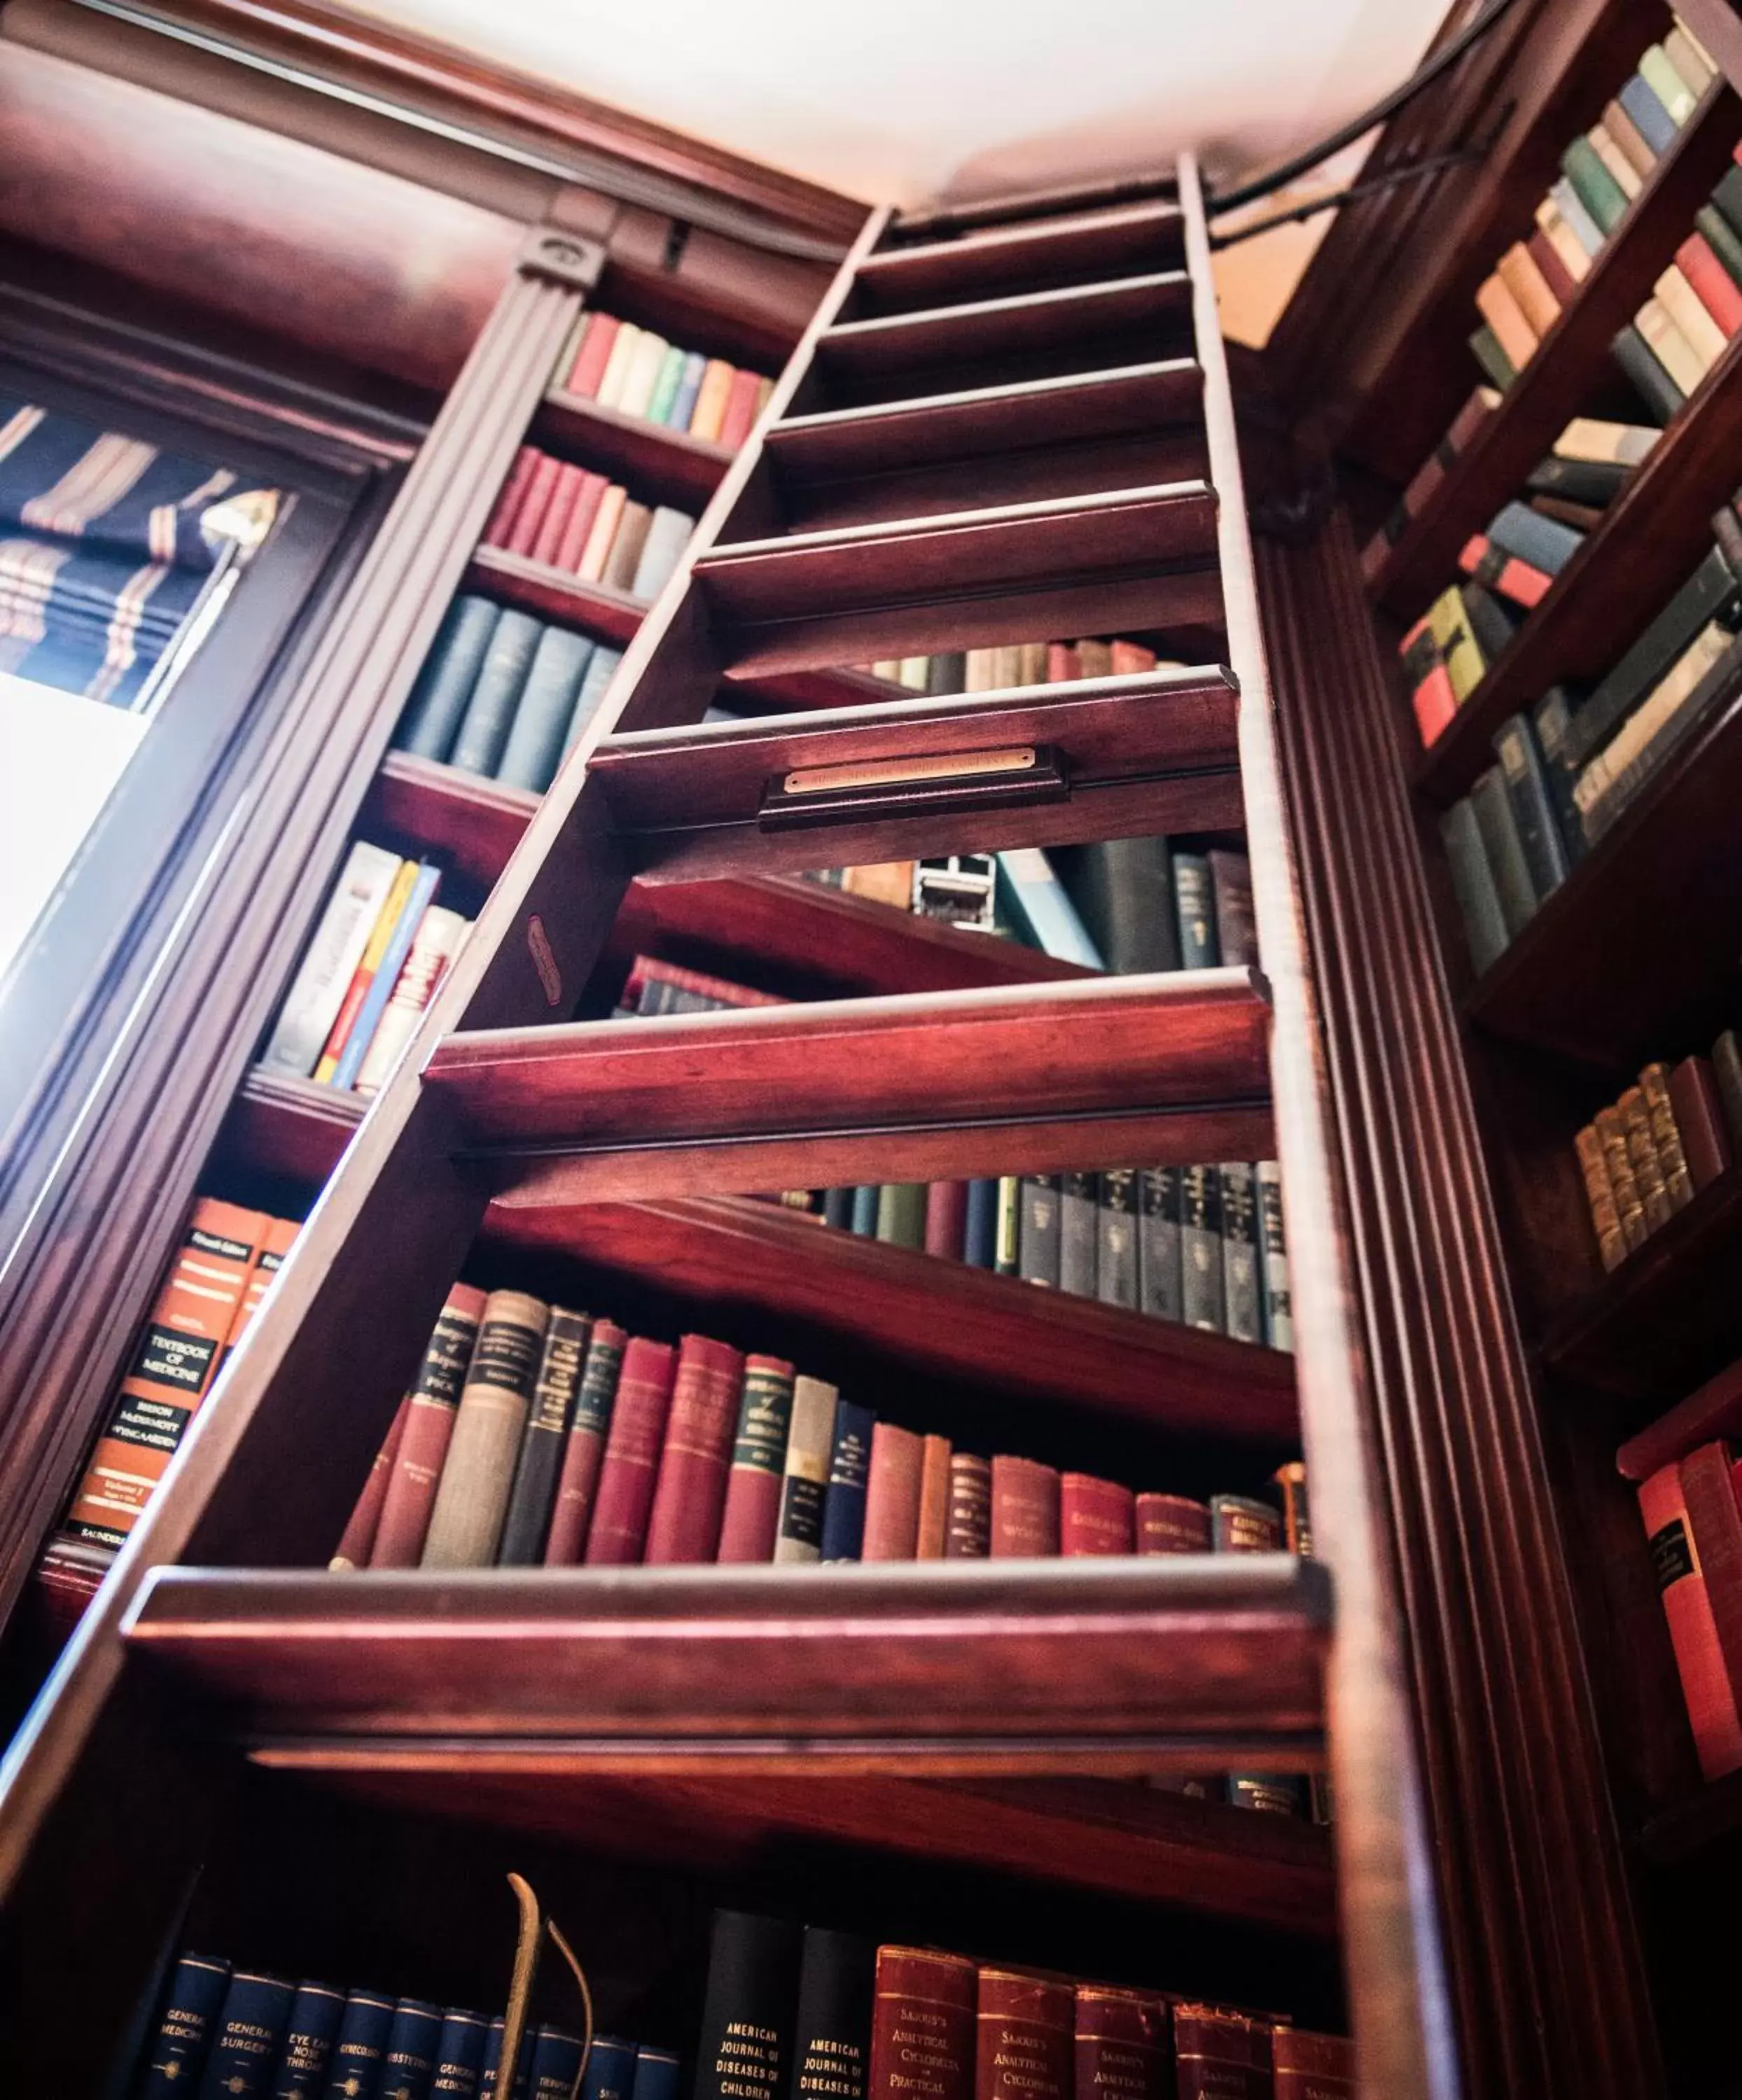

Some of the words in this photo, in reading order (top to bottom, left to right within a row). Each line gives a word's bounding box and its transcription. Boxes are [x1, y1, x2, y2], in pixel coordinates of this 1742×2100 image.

[152, 1334, 210, 1360] TEXTBOOK
[166, 1352, 185, 1365] OF
[141, 1358, 200, 1383] MEDICINE
[227, 2021, 272, 2040] GENERA
[289, 2033, 309, 2046] EYE
[726, 2022, 777, 2043] AMERICAN
[720, 2040, 765, 2059] JOURNAL
[809, 2038, 860, 2059] AMERICAN
[716, 2059, 765, 2080] DISEASES
[768, 2069, 779, 2084] OF
[804, 2057, 848, 2075] JOURNAL
[720, 2081, 771, 2100] CHILDREN
[800, 2075, 850, 2094] DISEASES
[890, 2073, 945, 2095] PRACTICAL
